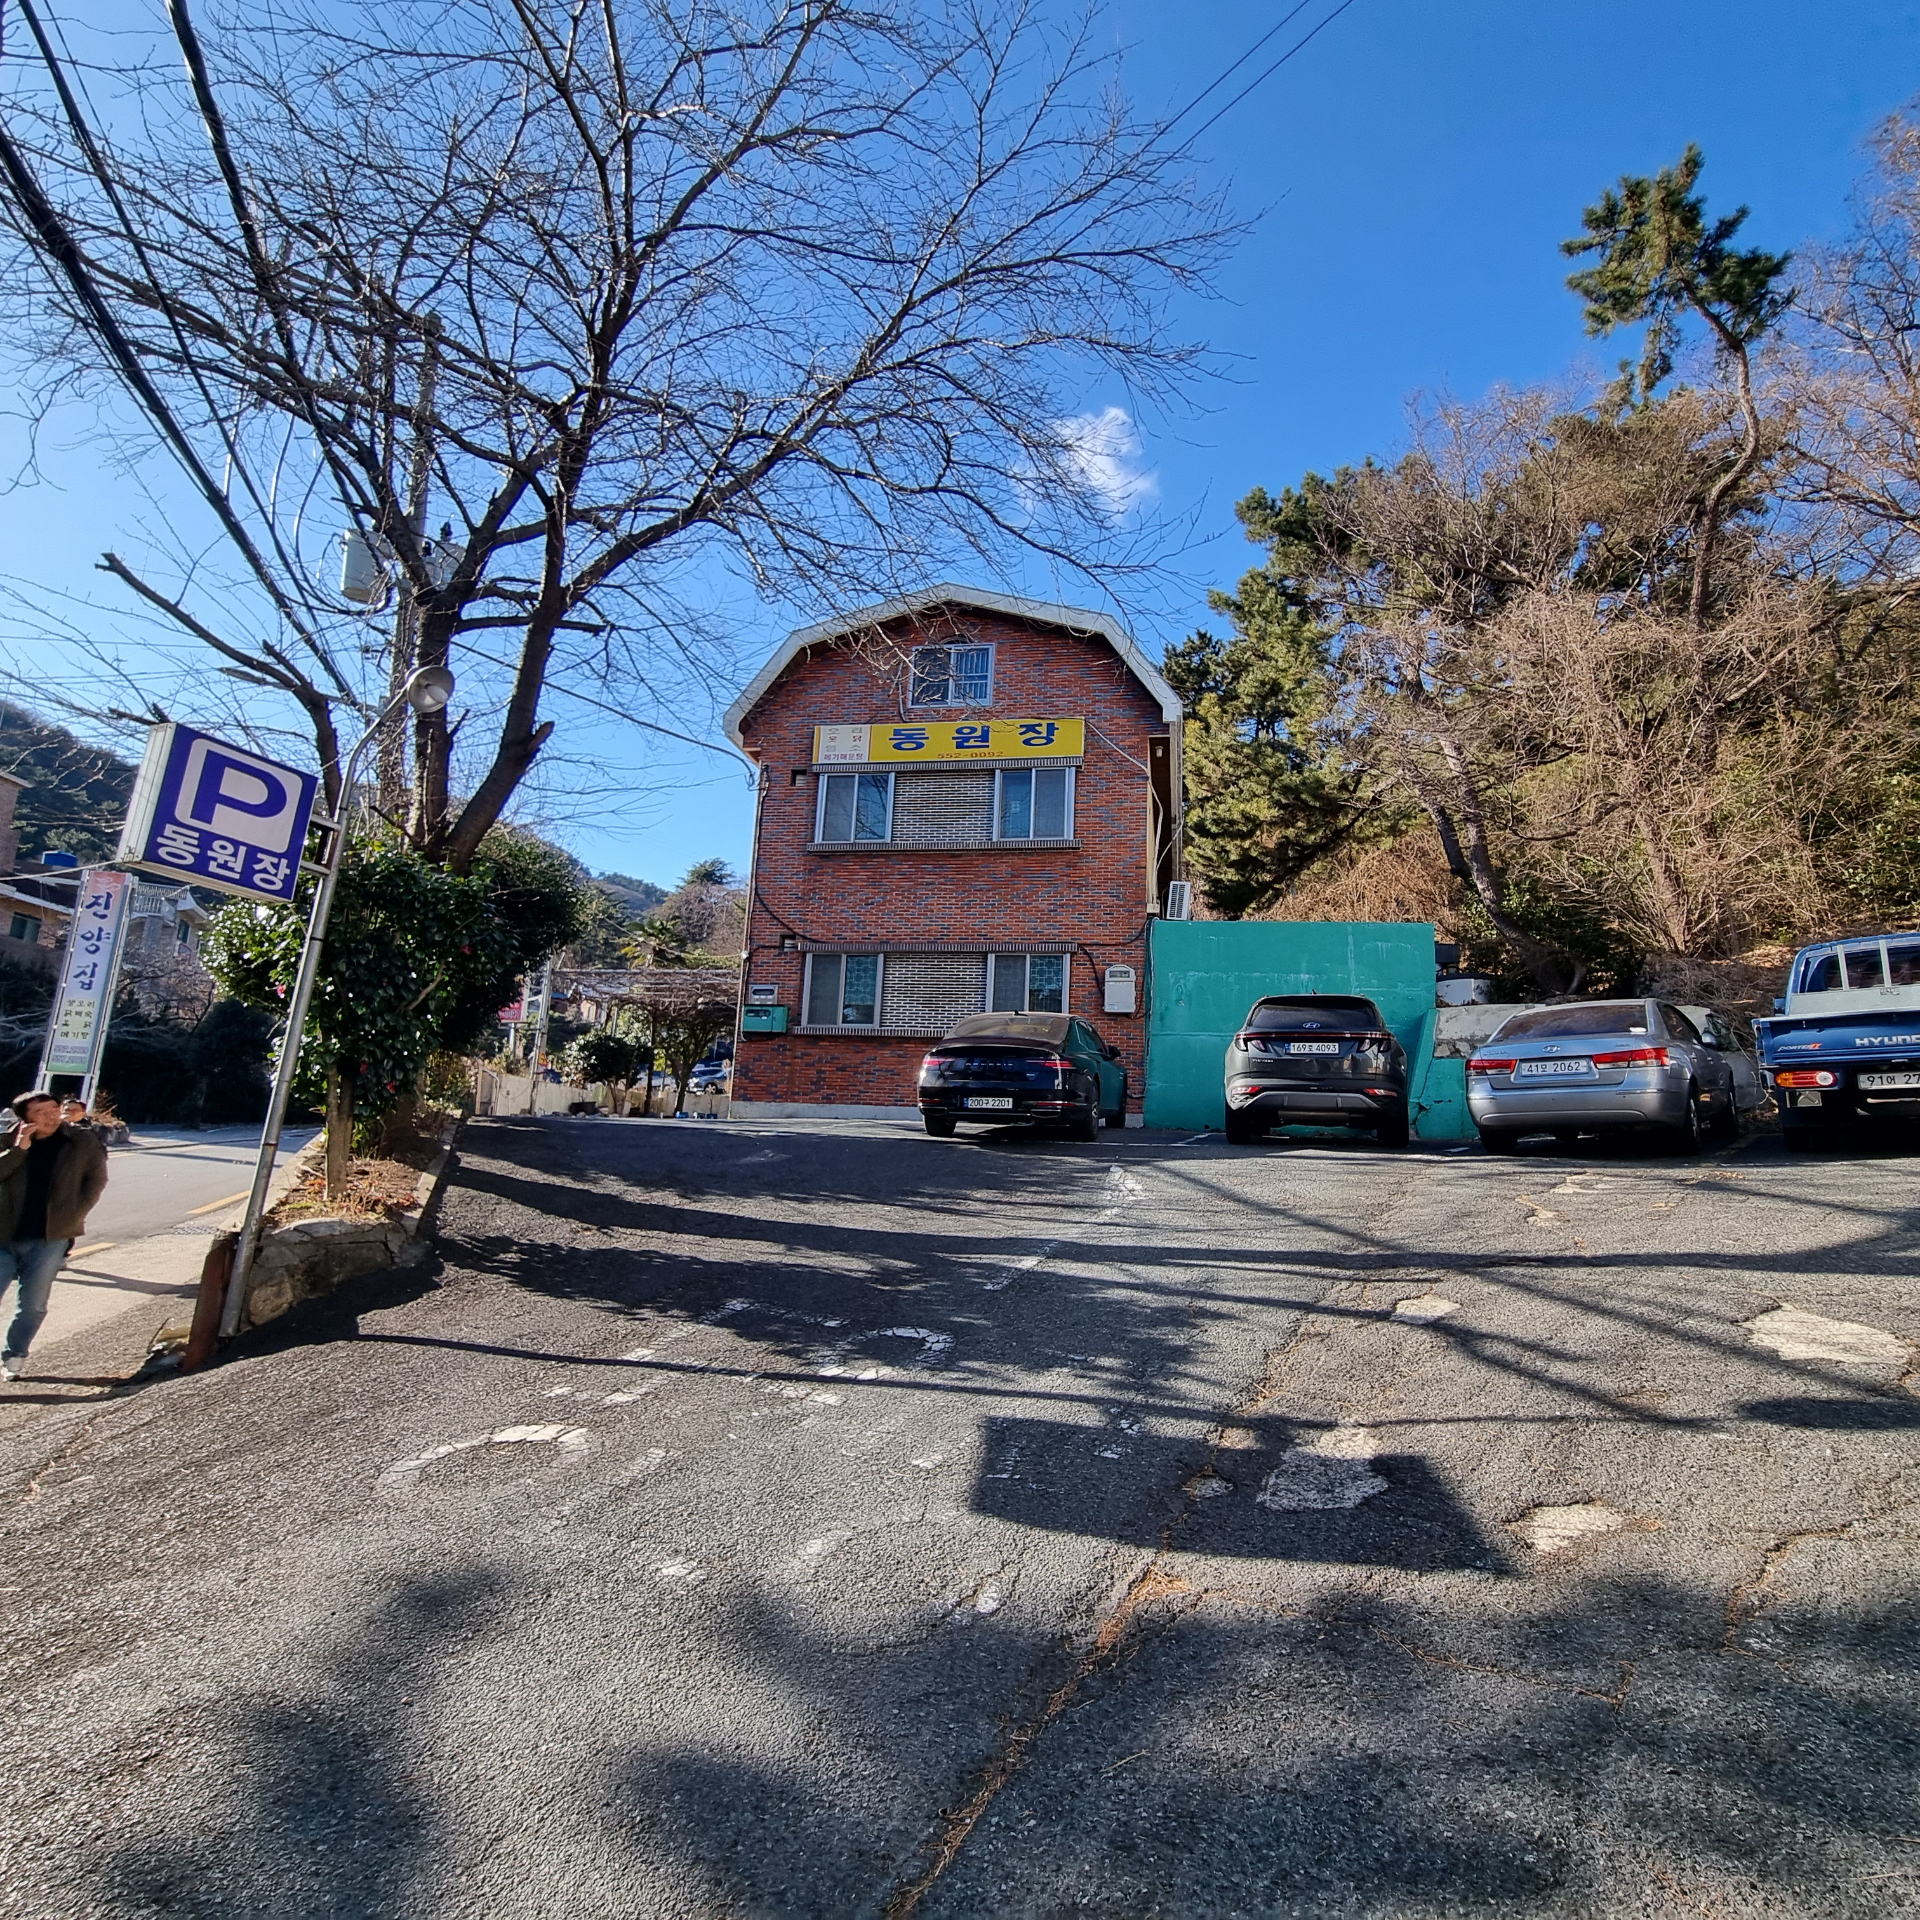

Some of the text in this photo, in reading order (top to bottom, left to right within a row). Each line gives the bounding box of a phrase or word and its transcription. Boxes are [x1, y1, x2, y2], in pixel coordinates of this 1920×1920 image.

[889, 722, 1059, 751] 동원장
[937, 751, 1004, 759] 552-0092
[190, 749, 287, 825] P
[156, 823, 291, 891] 동원장
[73, 891, 113, 991] 진양집
[1315, 1043, 1337, 1052] 4093
[1552, 1061, 1581, 1072] 2062
[1866, 1075, 1896, 1086] 91어
[991, 1098, 1010, 1107] 2201
